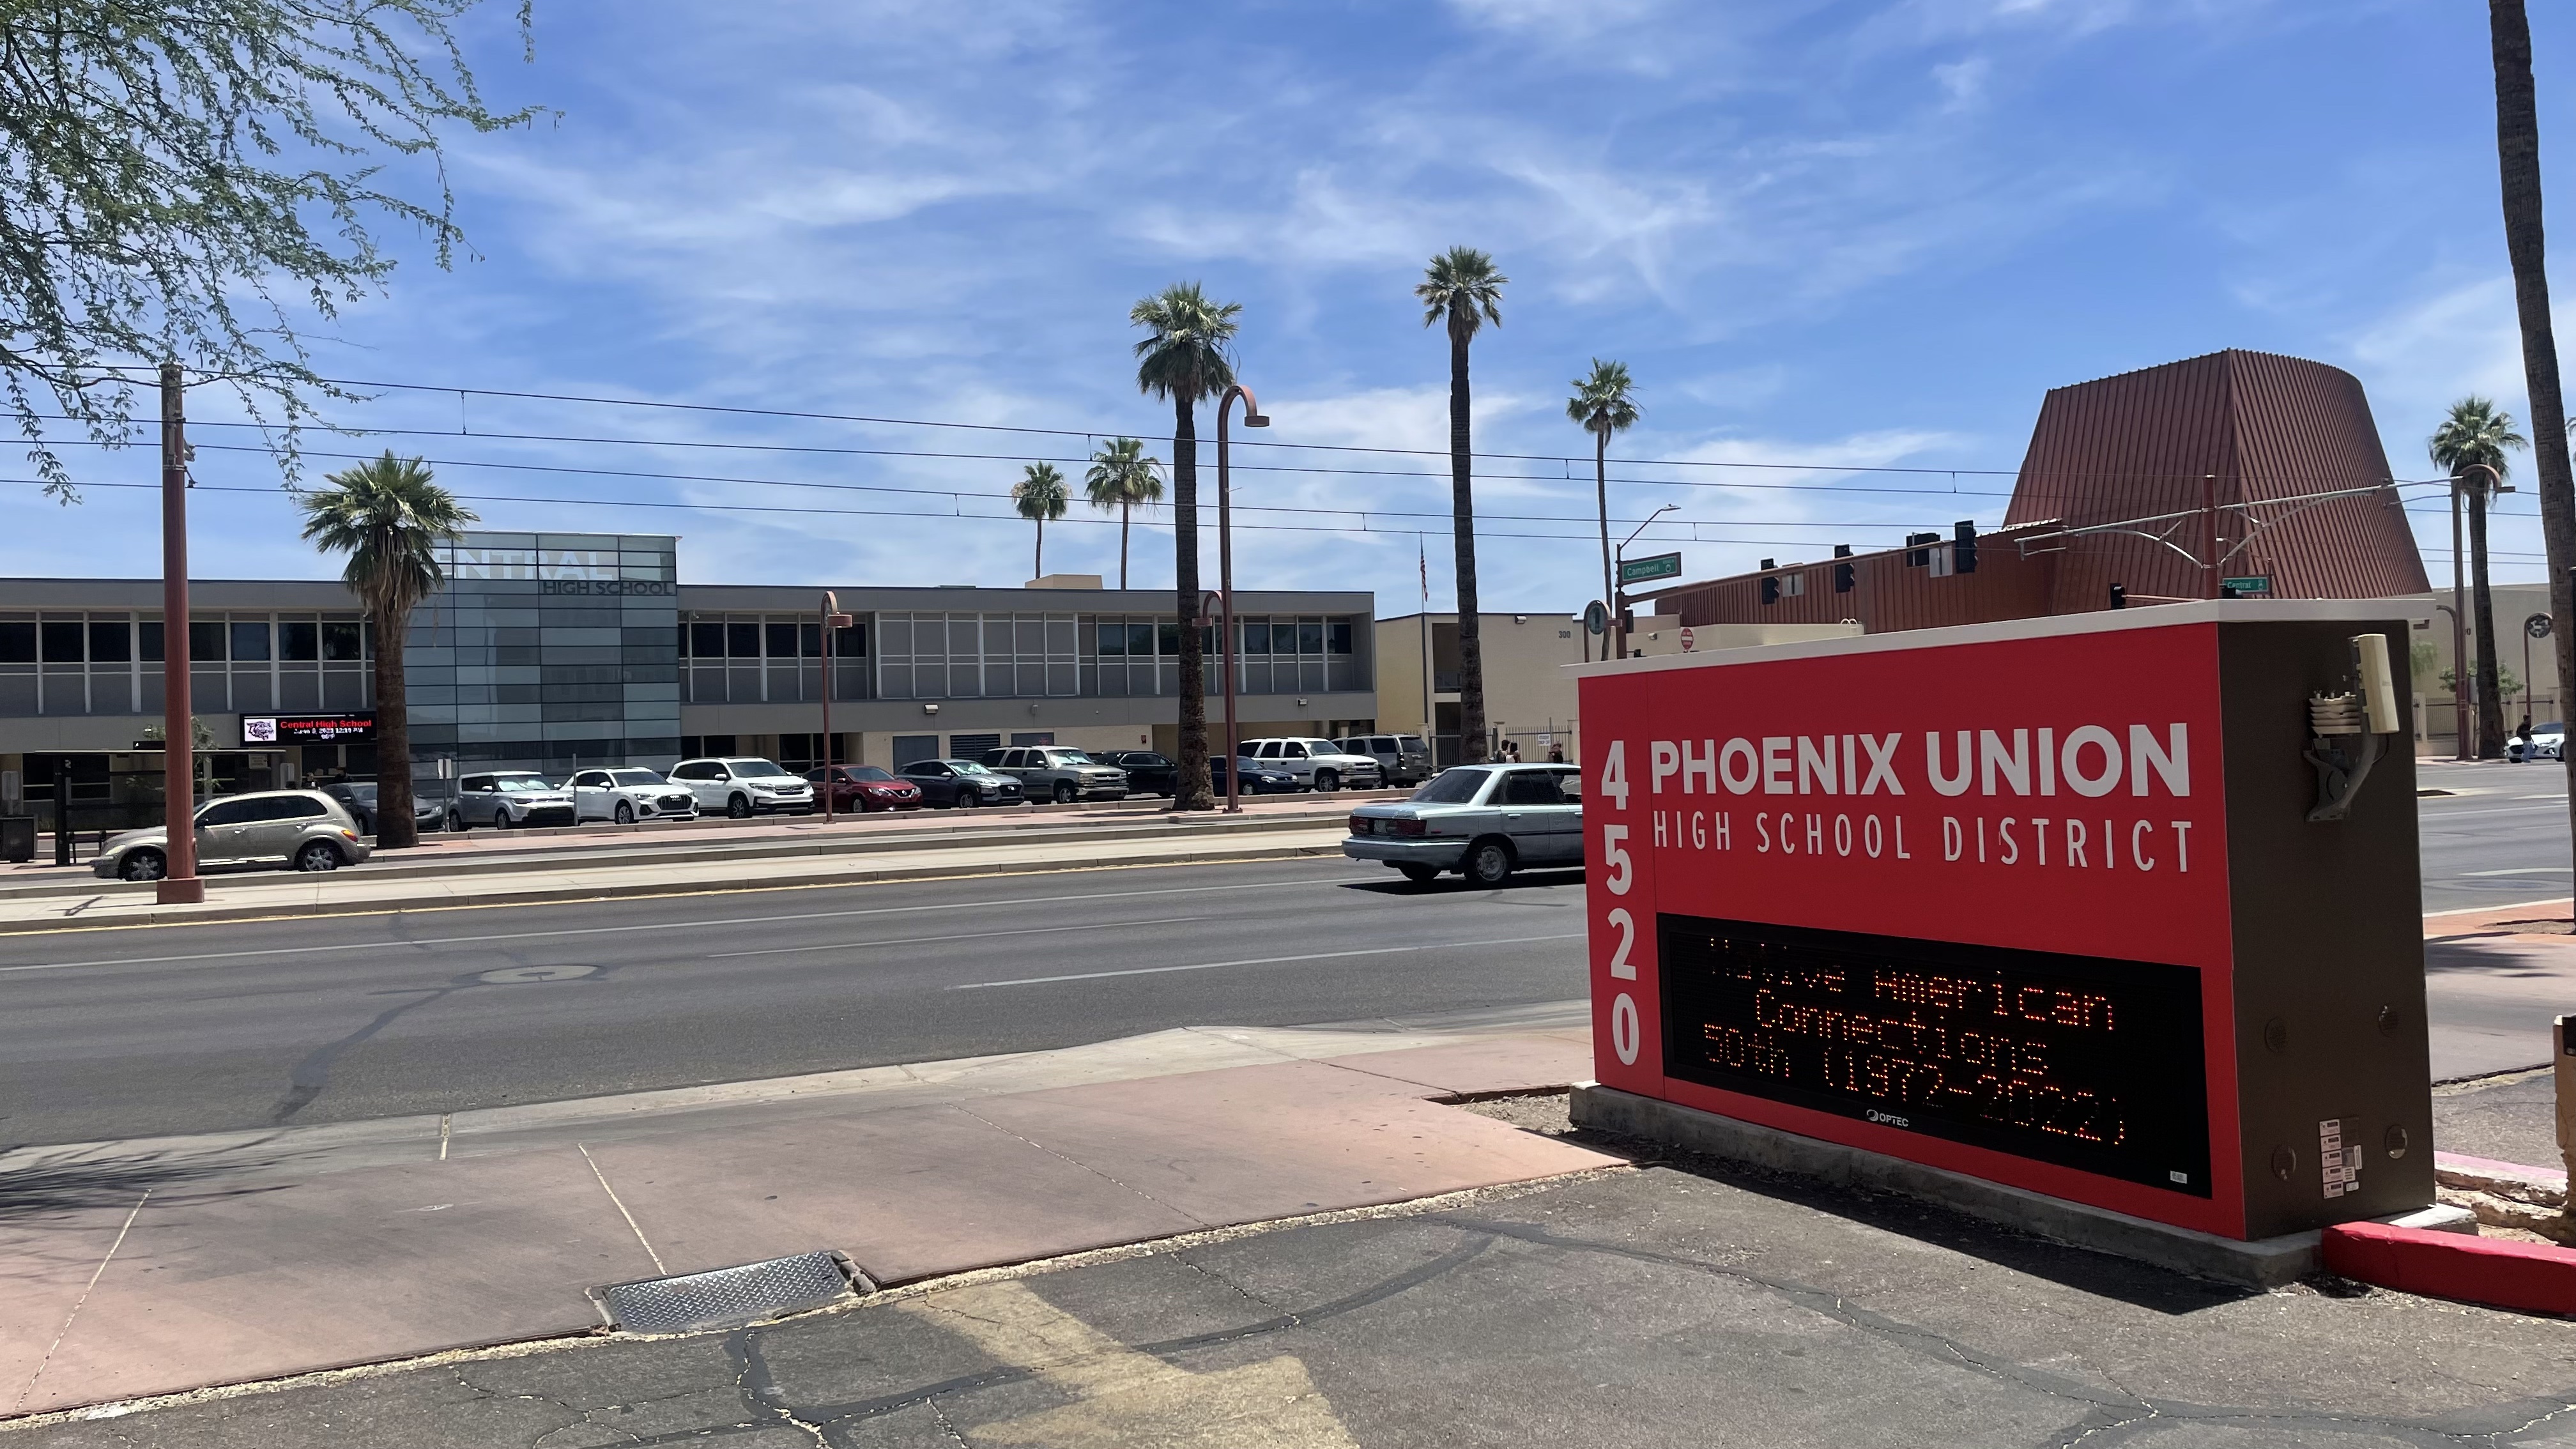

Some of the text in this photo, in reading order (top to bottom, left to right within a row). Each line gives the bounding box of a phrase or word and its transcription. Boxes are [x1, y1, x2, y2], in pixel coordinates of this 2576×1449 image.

[415, 548, 613, 581] ENTRAL
[543, 581, 673, 595] HIGH SCHOOL
[1627, 564, 1659, 576] Campbell
[316, 720, 337, 729] High
[339, 719, 372, 728] School
[1651, 723, 2191, 797] PHOENIX UNION
[1653, 810, 2192, 873] HIGH SCHOOL DISTRICT
[1601, 740, 1639, 1066] 4520
[1874, 965, 2113, 1031] American
[1756, 988, 2049, 1075] Connections
[1704, 1023, 2125, 1145] 50th (1972-2022)
[1879, 1113, 1909, 1127] OPTEC
